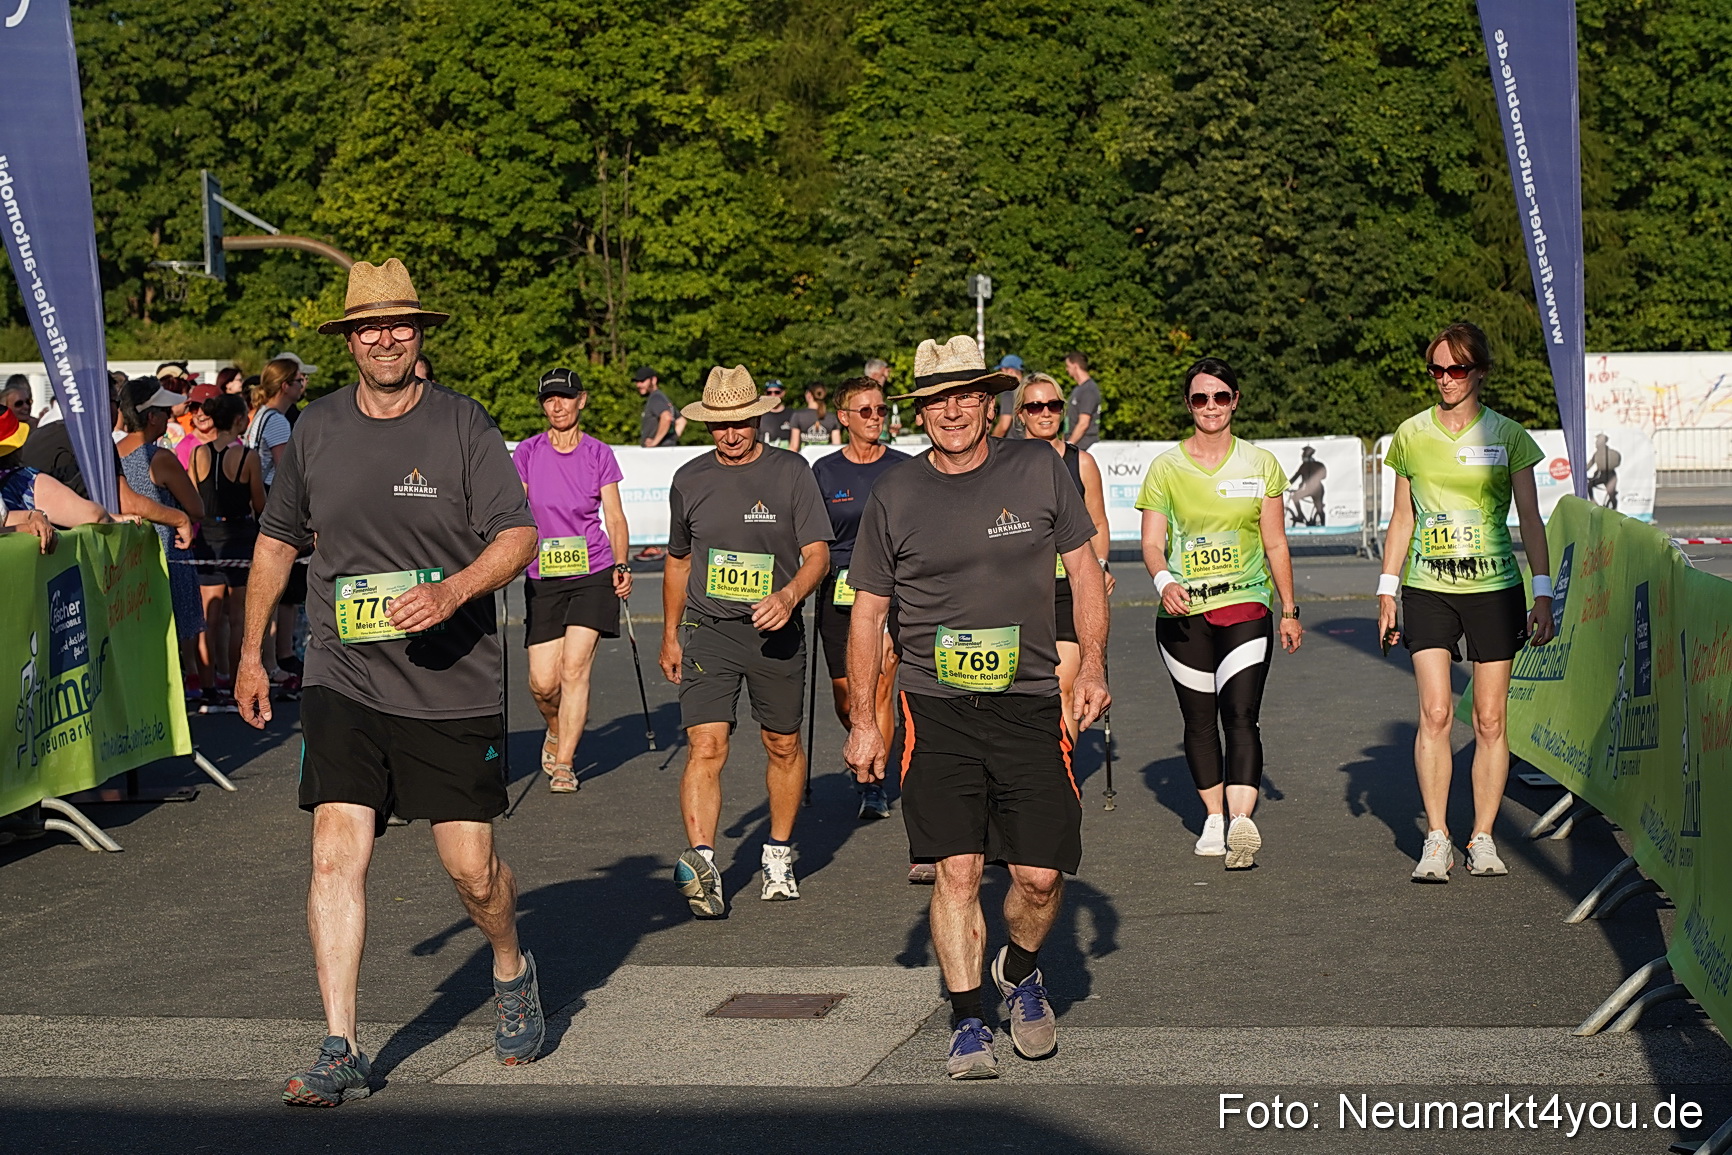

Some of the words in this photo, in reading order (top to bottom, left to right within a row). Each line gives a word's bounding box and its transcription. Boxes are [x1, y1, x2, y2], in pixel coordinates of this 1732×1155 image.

[1108, 463, 1142, 476] NOW
[393, 485, 438, 494] BURKHARDT
[987, 521, 1031, 535] BURKHARDT
[1431, 526, 1473, 543] 1145
[1473, 528, 1481, 550] 2022
[546, 550, 581, 564] 1886
[1191, 547, 1232, 566] 1305
[1232, 548, 1240, 569] 2022
[1211, 563, 1233, 571] Sandra
[718, 567, 760, 587] 1011
[761, 574, 770, 596] 2022
[716, 584, 740, 593] Schardt
[339, 604, 349, 635] WALK
[355, 621, 377, 630] Meier
[378, 619, 392, 628] En
[939, 651, 949, 678] WALK
[955, 650, 1000, 672] 769
[1008, 652, 1016, 679] 2022
[948, 670, 978, 680] Sellerer
[979, 672, 1008, 681] Roland
